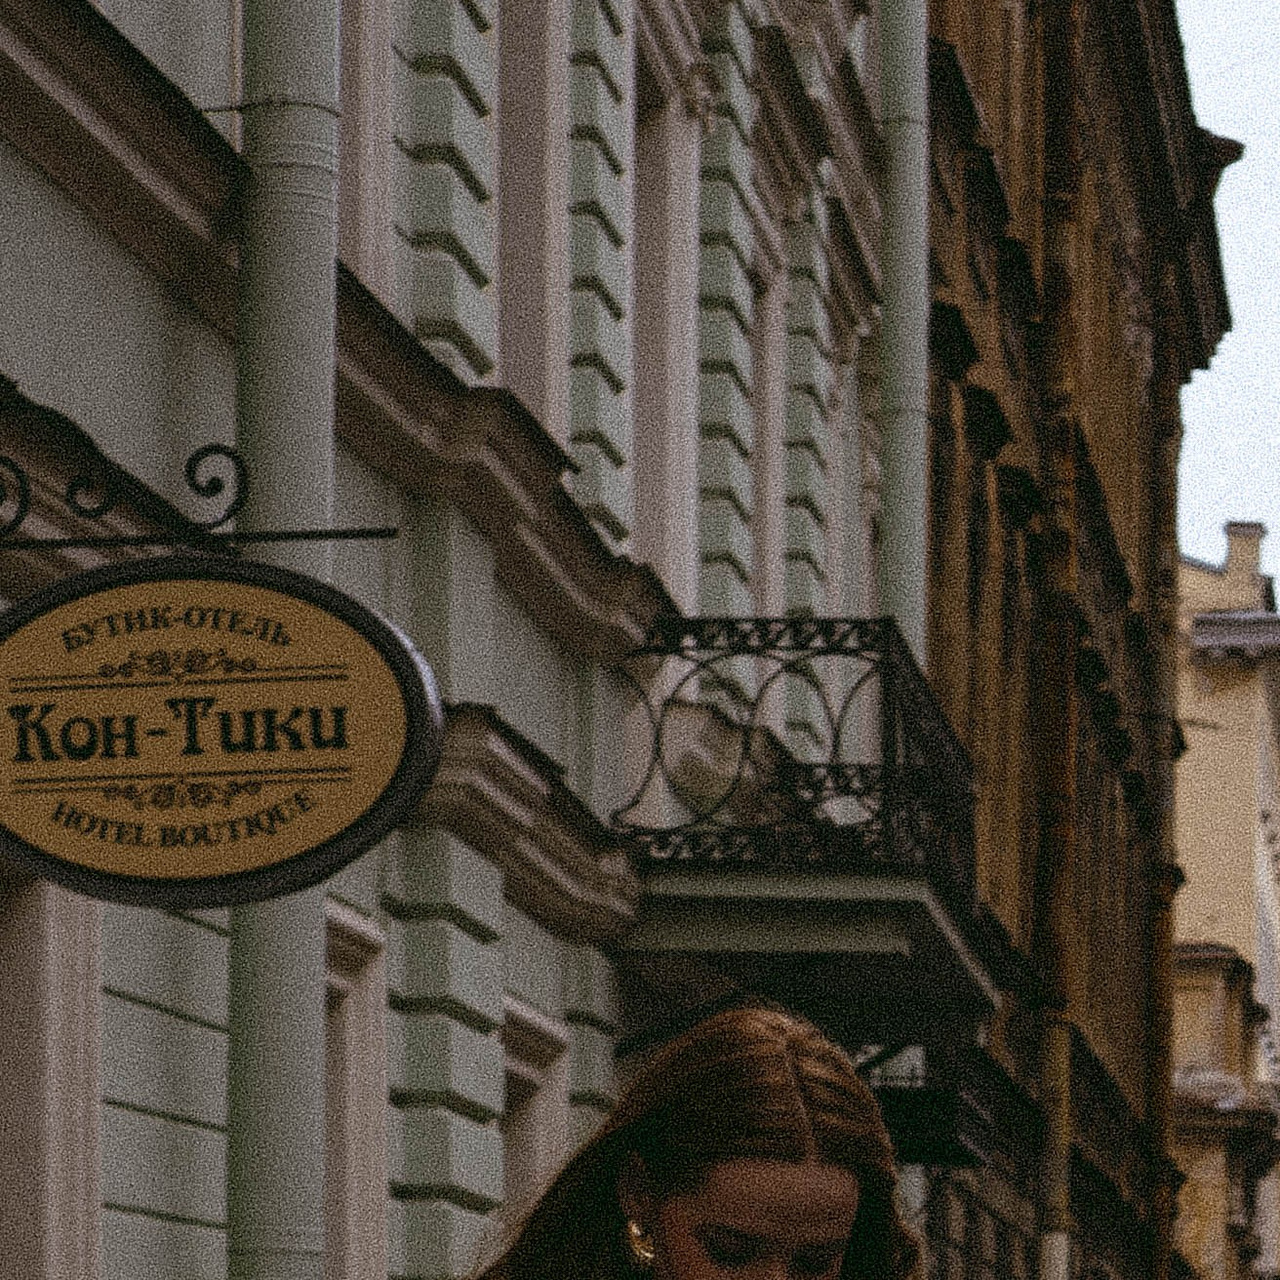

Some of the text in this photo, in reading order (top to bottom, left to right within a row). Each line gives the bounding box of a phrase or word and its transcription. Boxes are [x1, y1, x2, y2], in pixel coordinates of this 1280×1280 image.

[61, 605, 292, 653] БУТИК-ОТЕЛЬ
[7, 697, 350, 762] Кон-Тики
[50, 790, 316, 847] HOTEL BOUTIQUE
